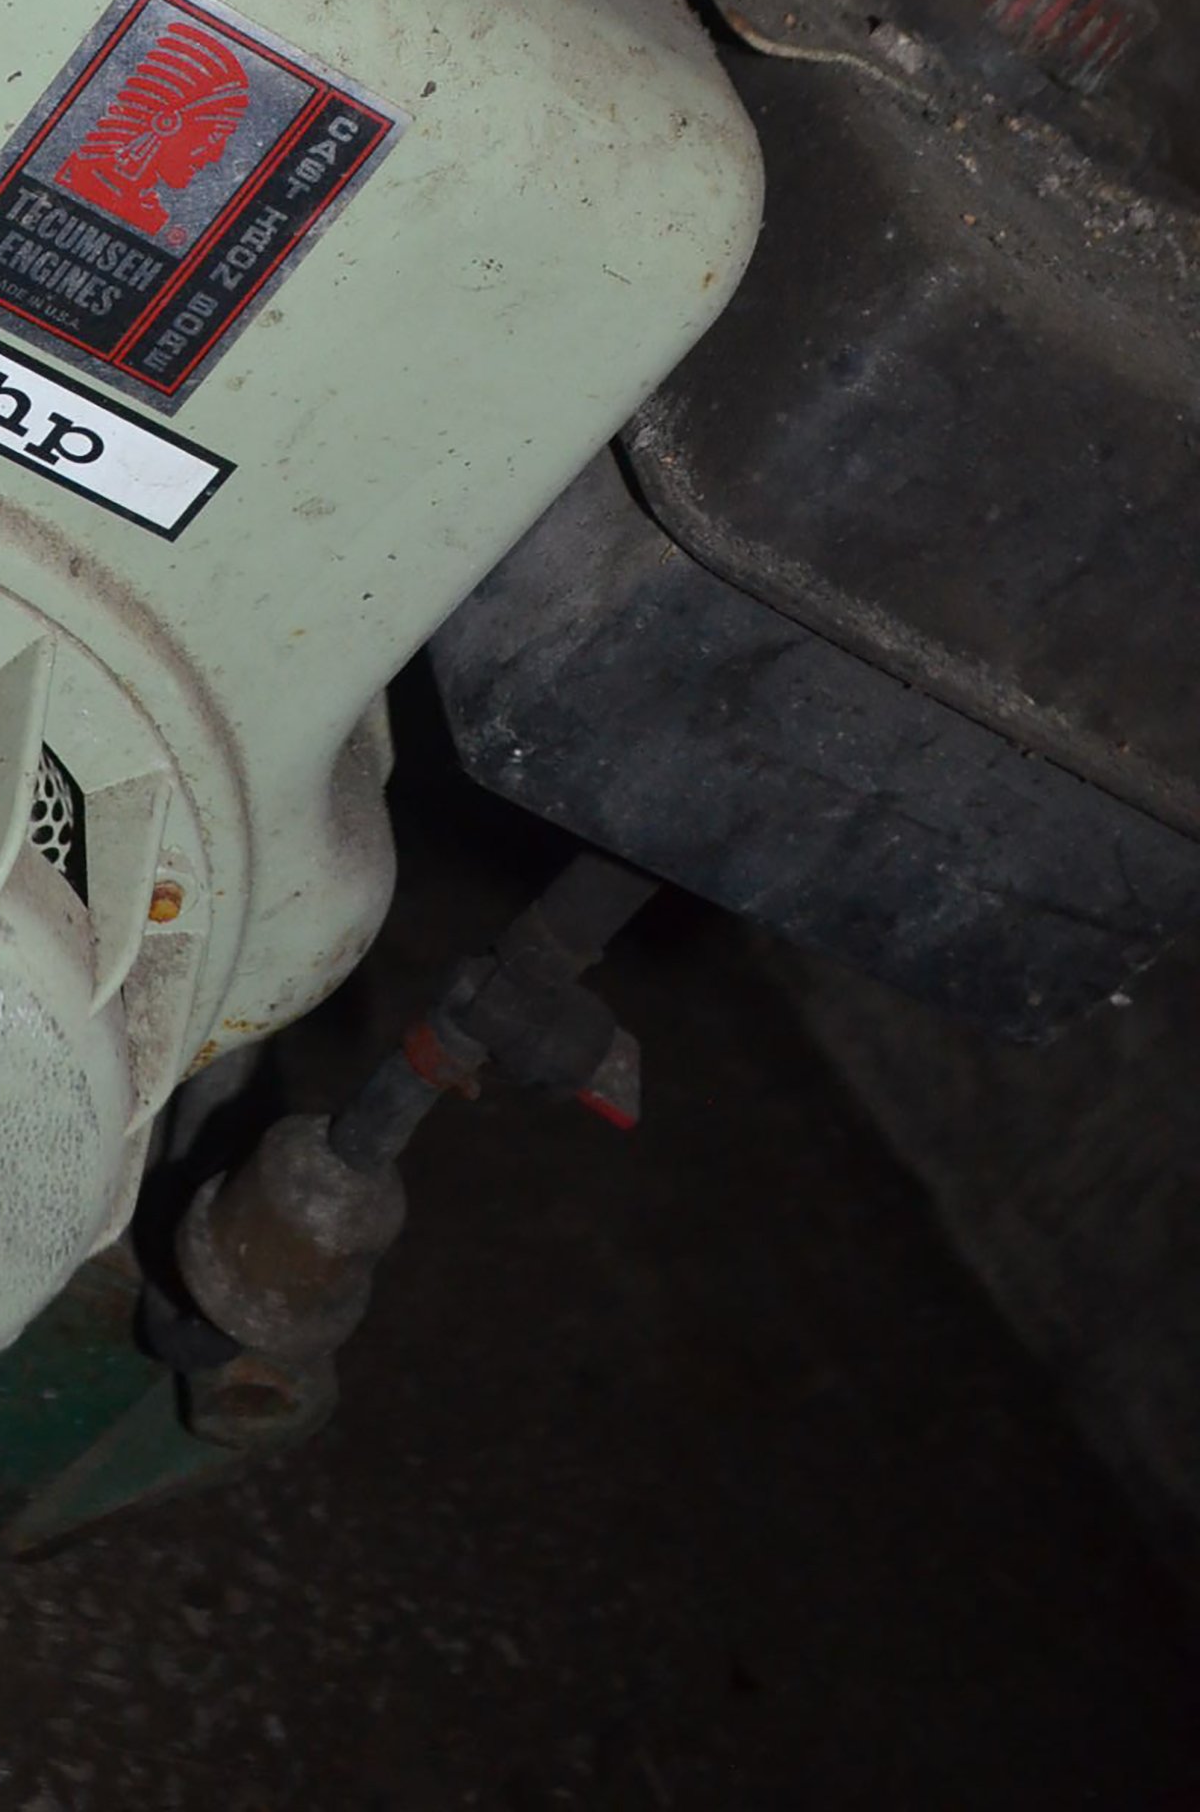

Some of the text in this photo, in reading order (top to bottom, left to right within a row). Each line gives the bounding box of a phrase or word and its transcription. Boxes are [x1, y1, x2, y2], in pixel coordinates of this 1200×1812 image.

[5, 187, 164, 291] TECUMSEH
[143, 115, 359, 372] CAST IRON BORE
[28, 294, 46, 309] IN
